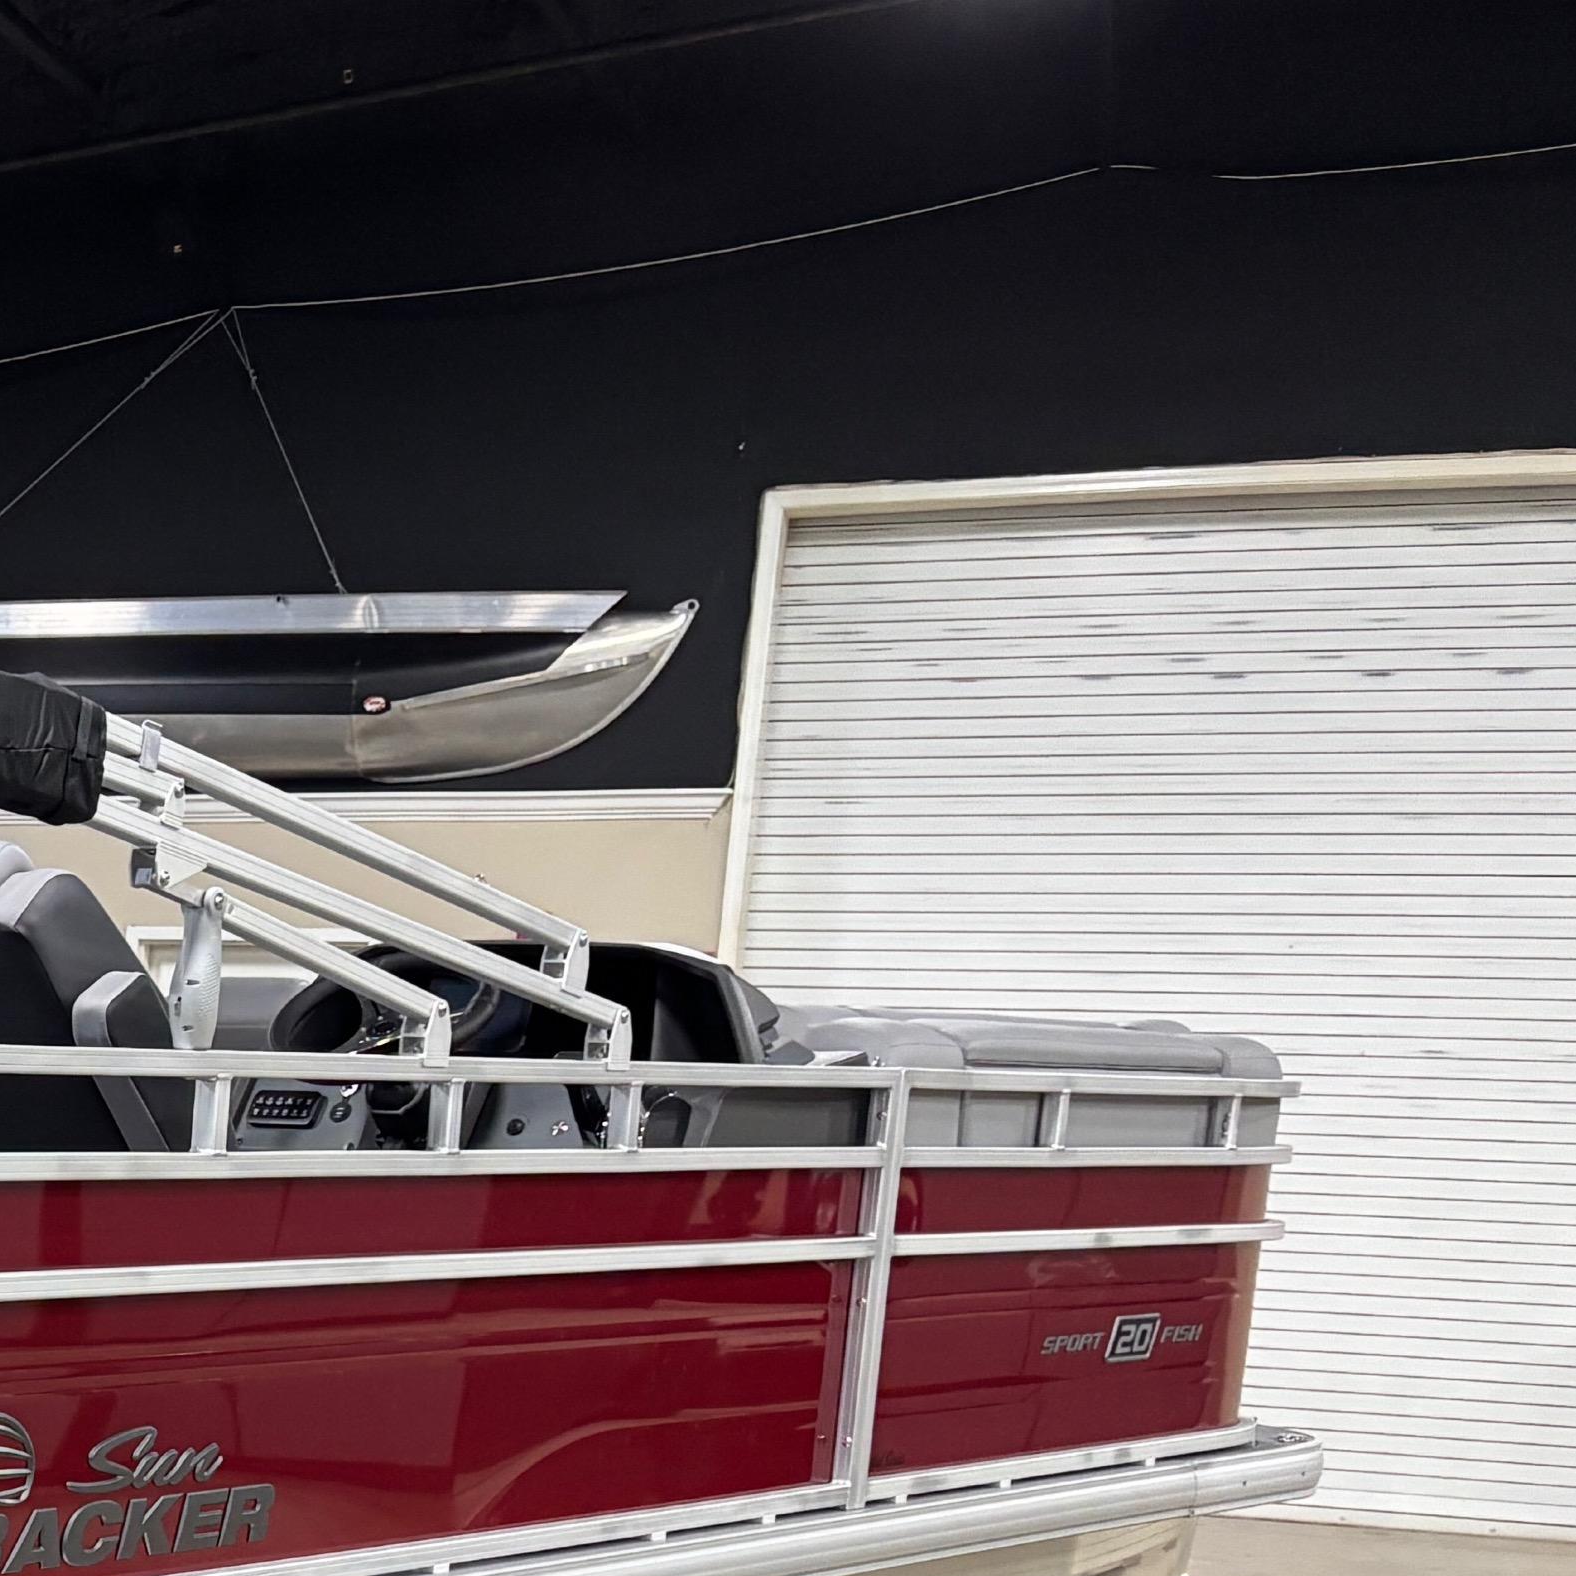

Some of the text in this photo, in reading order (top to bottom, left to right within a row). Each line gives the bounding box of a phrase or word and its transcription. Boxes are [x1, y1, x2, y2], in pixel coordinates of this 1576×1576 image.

[1040, 1323, 1204, 1355] SPORT 20 FISH
[66, 1425, 224, 1494] Sun
